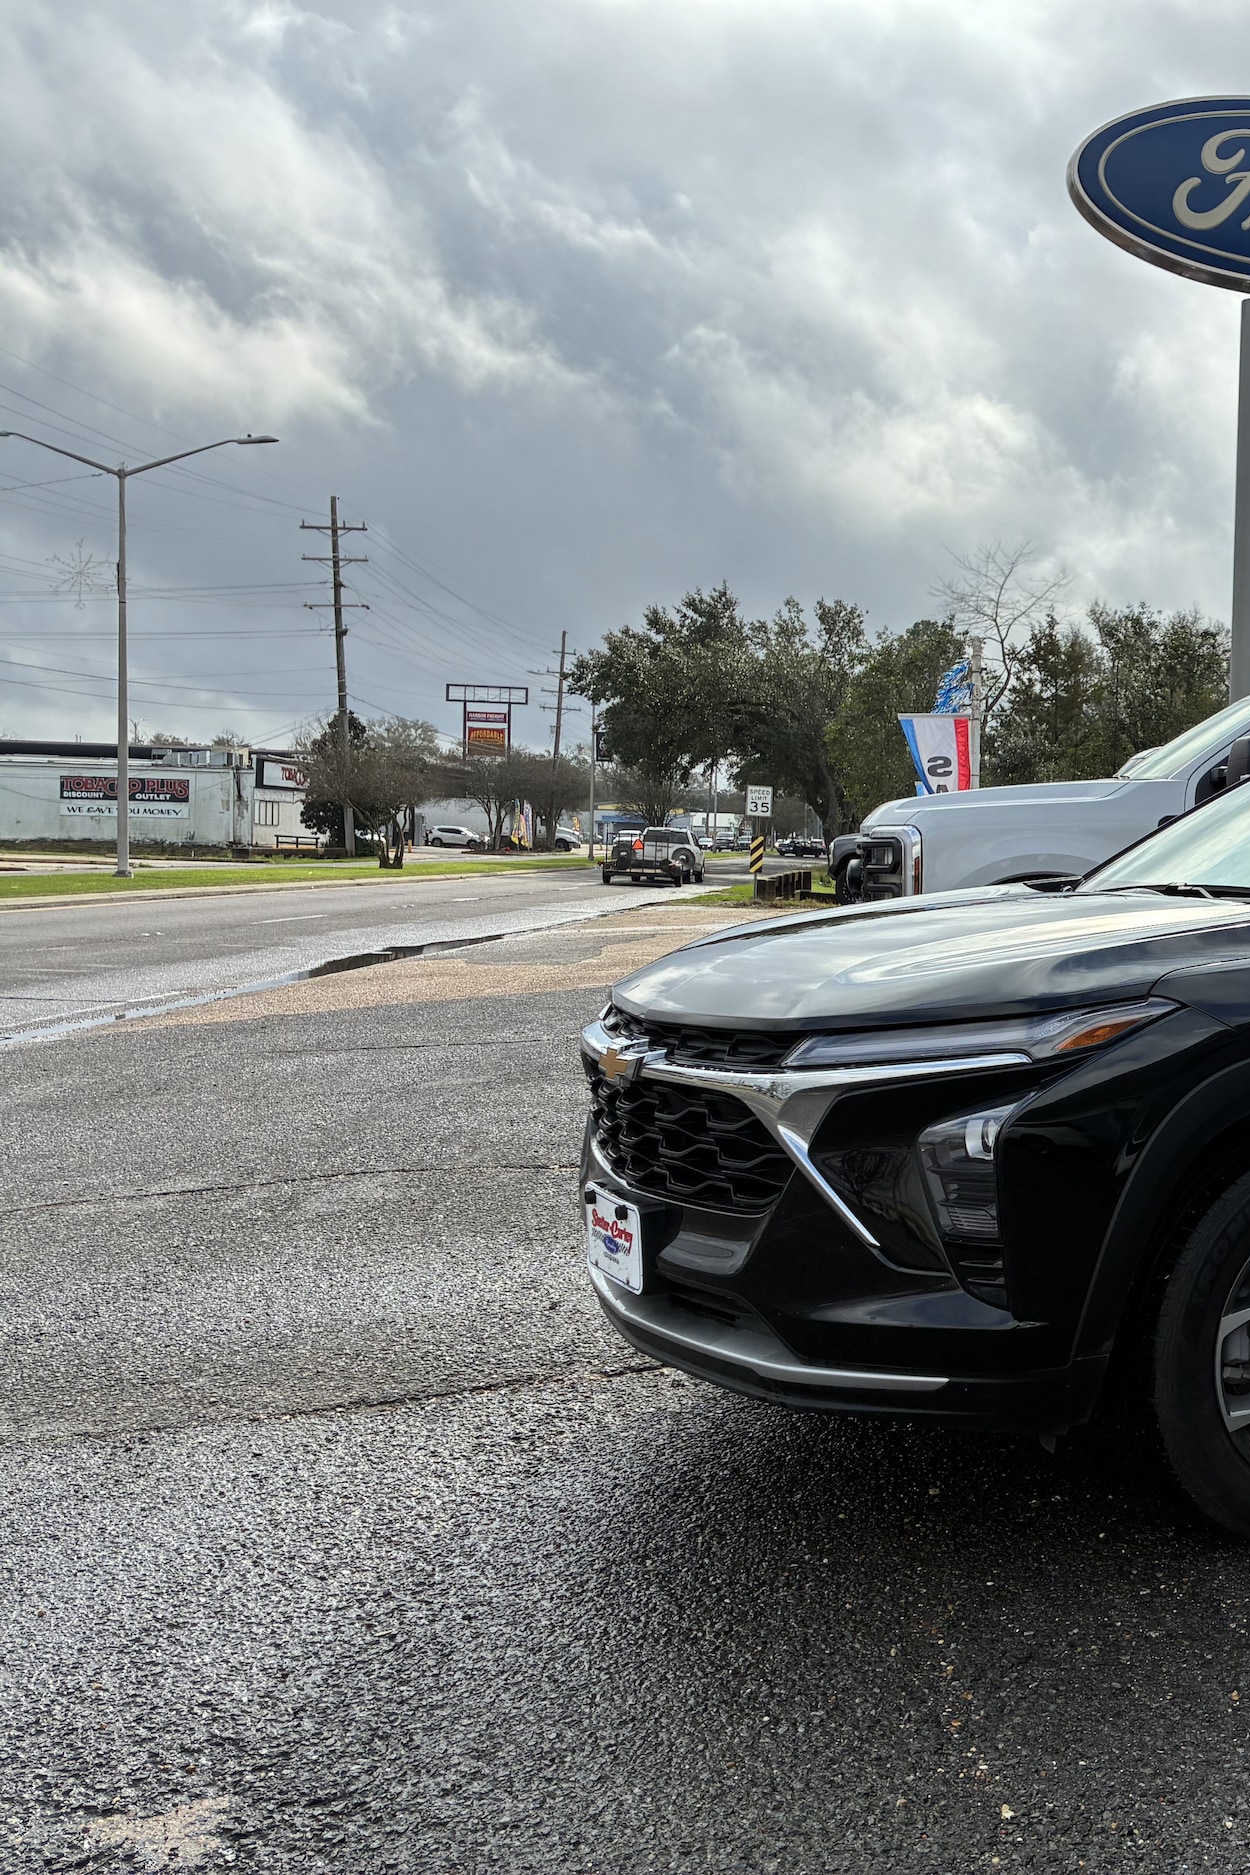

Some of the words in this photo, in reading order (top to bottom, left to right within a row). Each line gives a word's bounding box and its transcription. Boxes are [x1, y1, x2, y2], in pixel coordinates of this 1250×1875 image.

[61, 777, 142, 797] TOBACO
[144, 779, 189, 798] PLUS
[63, 791, 105, 799] DISCOUNT
[135, 793, 172, 801] OUTLET
[67, 806, 83, 814] WE
[142, 808, 182, 816] MONEY
[749, 801, 770, 813] 35
